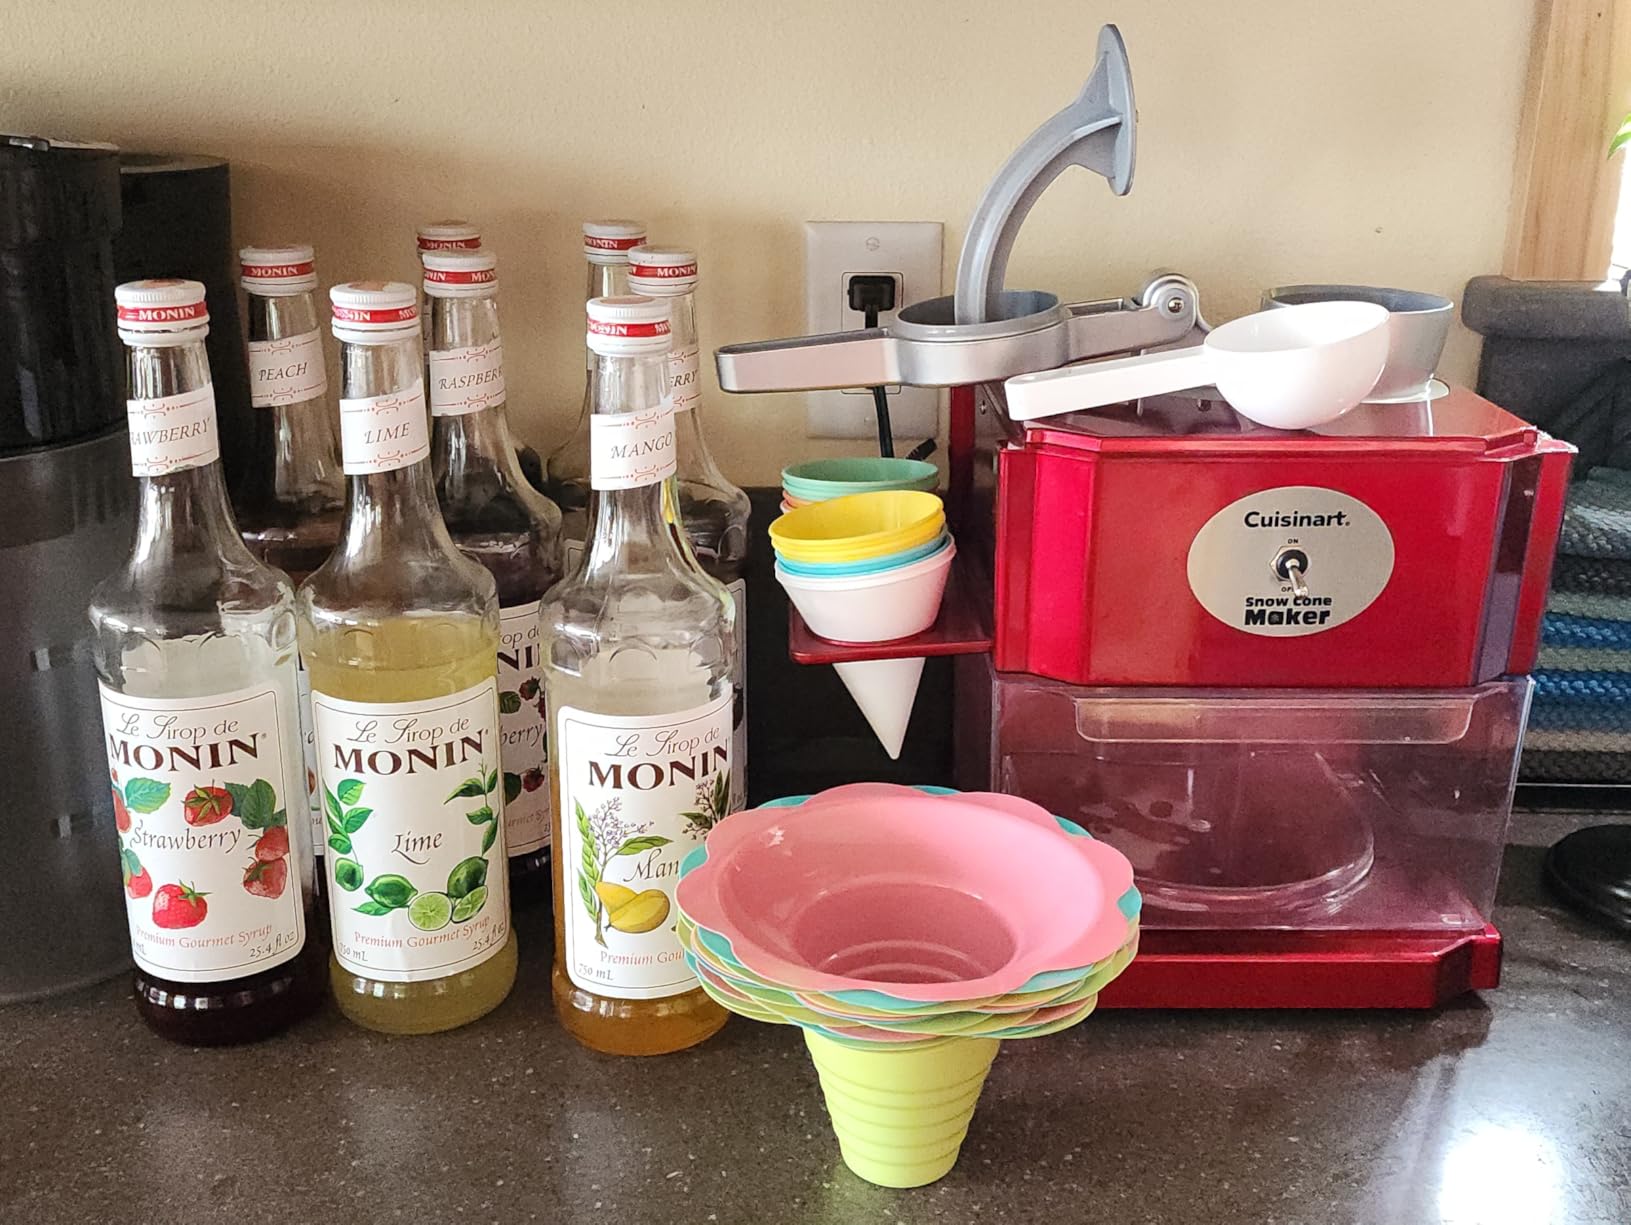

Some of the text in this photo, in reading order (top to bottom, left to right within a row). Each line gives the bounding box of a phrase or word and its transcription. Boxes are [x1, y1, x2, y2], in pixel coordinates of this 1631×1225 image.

[251, 264, 299, 277] MONIN
[138, 306, 196, 321] MONIN
[258, 361, 308, 382] PEACH
[364, 422, 410, 445] LIME
[610, 431, 673, 460] MANGO
[1244, 510, 1347, 529] Cuisinart
[1245, 596, 1290, 608] Snow
[1244, 608, 1331, 626] Maker
[115, 712, 240, 745] Le Sirop de
[346, 718, 470, 748] Le Sirop de
[108, 731, 260, 773] MONIN
[333, 728, 486, 776] MONIN
[604, 727, 720, 758] Le Sirop de
[588, 737, 729, 791] MONIN
[129, 818, 242, 854] Strawberry
[390, 830, 443, 866] Lime
[178, 935, 235, 950] Gourmet
[238, 923, 273, 947] Syrup
[249, 943, 272, 958] 25.4
[284, 931, 295, 944] oz
[354, 915, 490, 949] Premium Gourmet Syrup
[352, 948, 369, 962] mL
[599, 950, 654, 966] Premium
[595, 968, 615, 982] mL
